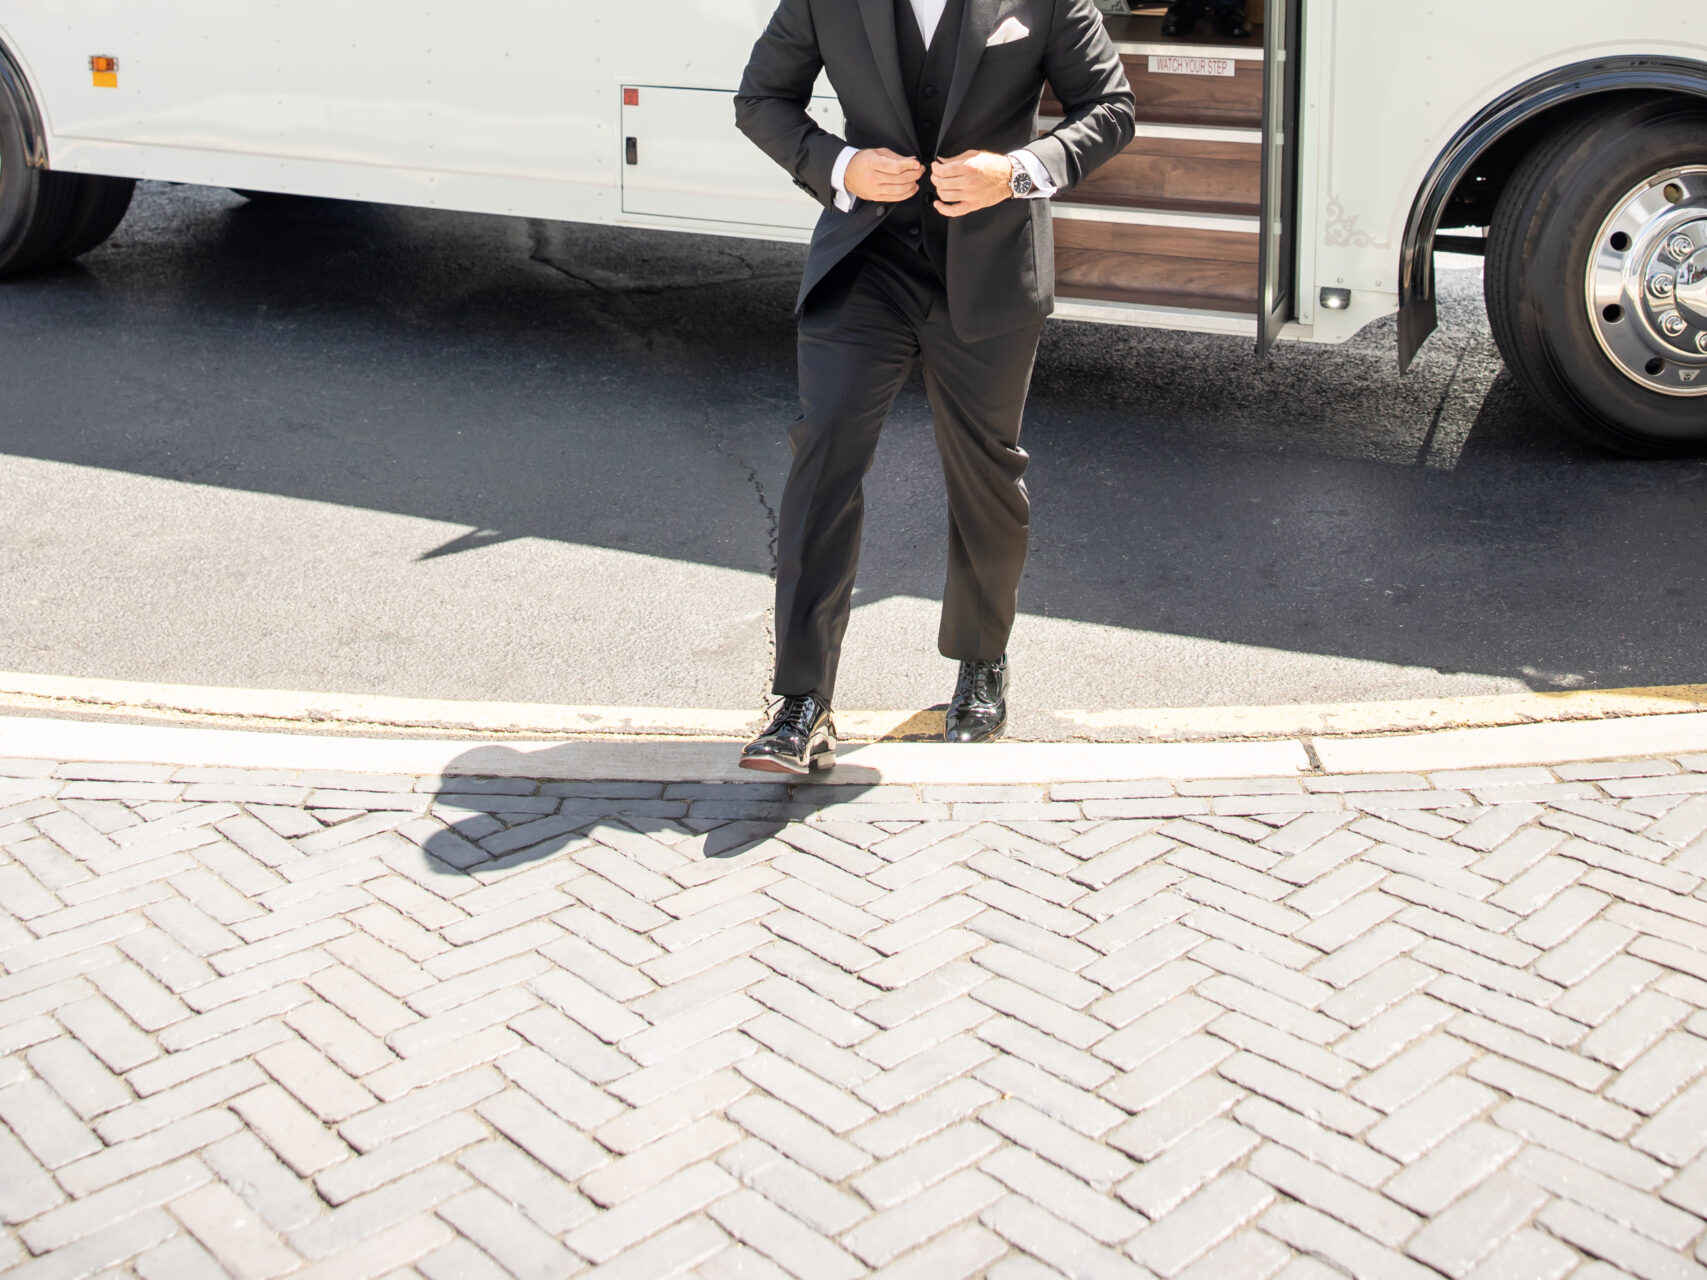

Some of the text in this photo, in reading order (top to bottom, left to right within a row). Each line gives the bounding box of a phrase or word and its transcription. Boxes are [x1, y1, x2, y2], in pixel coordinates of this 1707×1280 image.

[1156, 57, 1228, 75] WATCH YOUR STEP
